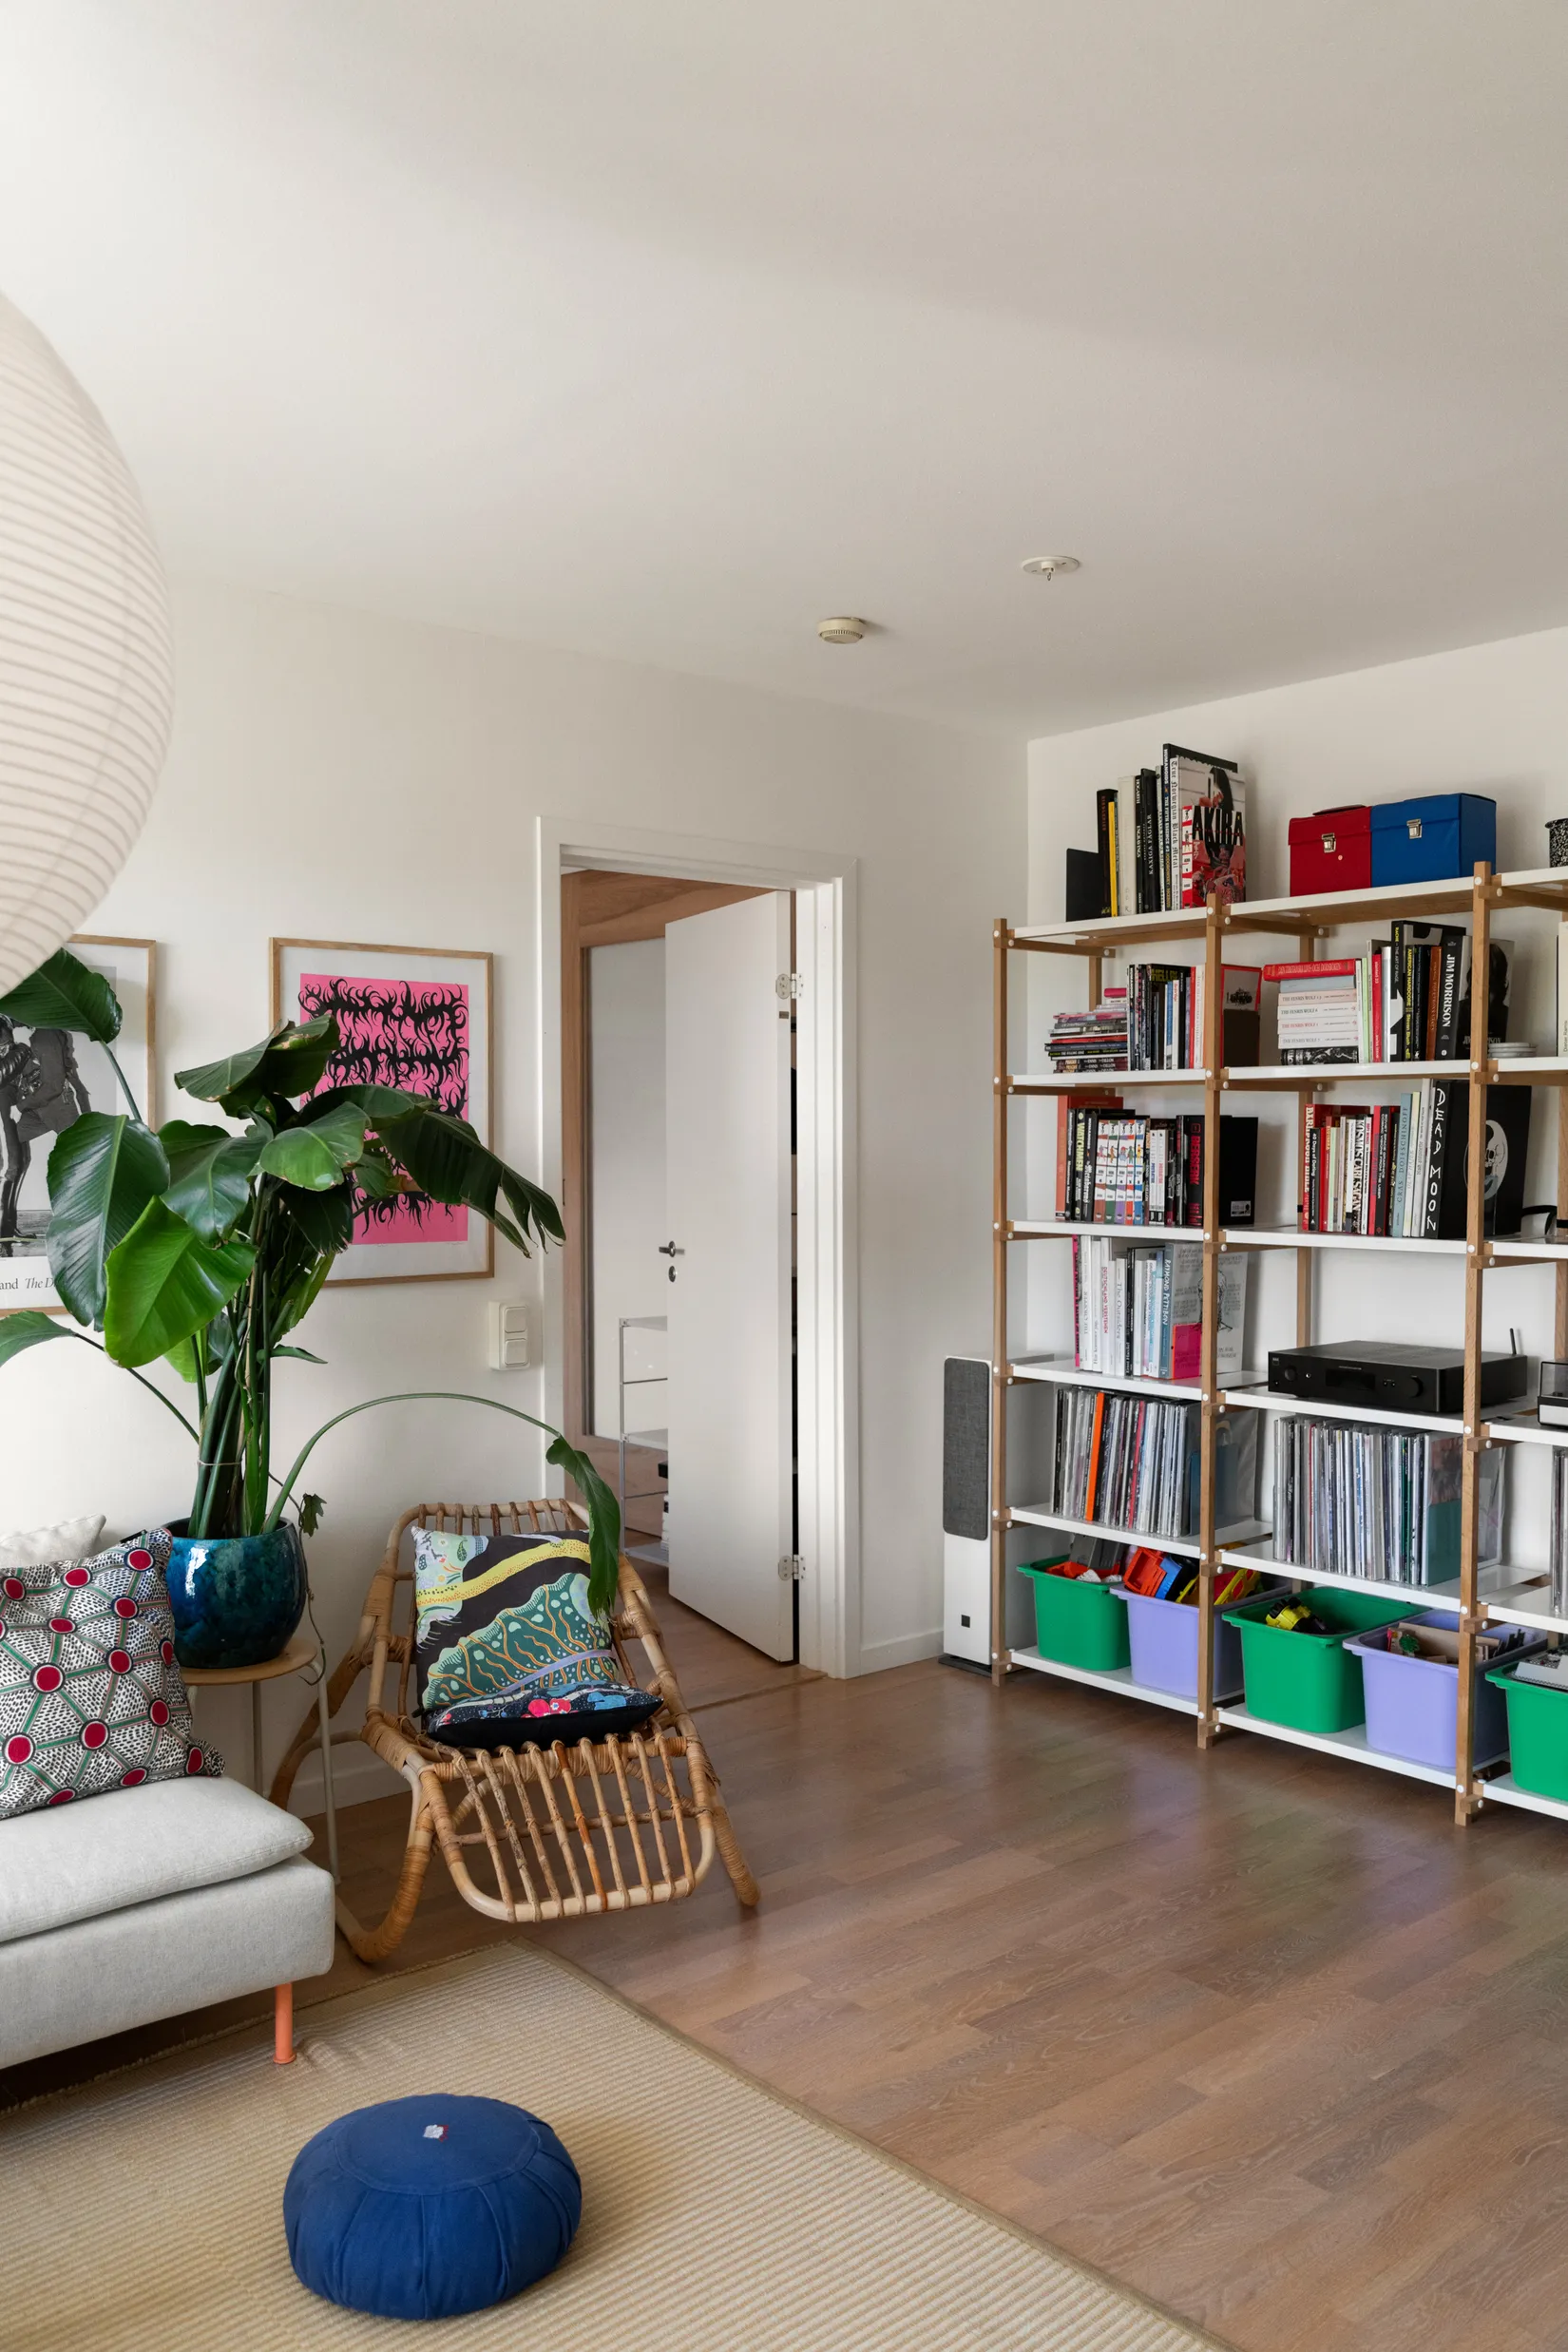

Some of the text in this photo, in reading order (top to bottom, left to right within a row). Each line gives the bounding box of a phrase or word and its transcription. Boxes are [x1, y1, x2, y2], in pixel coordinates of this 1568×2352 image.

[1192, 805, 1243, 847] AKIRA
[1442, 954, 1455, 1027] JIM MORRISON
[1076, 1122, 1085, 1172] WATCHMEN
[1190, 1135, 1201, 1185] BERSERK
[1352, 1119, 1365, 1212] KOSMOS CARL SAGAN
[1425, 1088, 1447, 1233] DEAD MOON
[25, 1277, 44, 1290] The
[1162, 1258, 1172, 1325] RAYMOND PETTIBON
